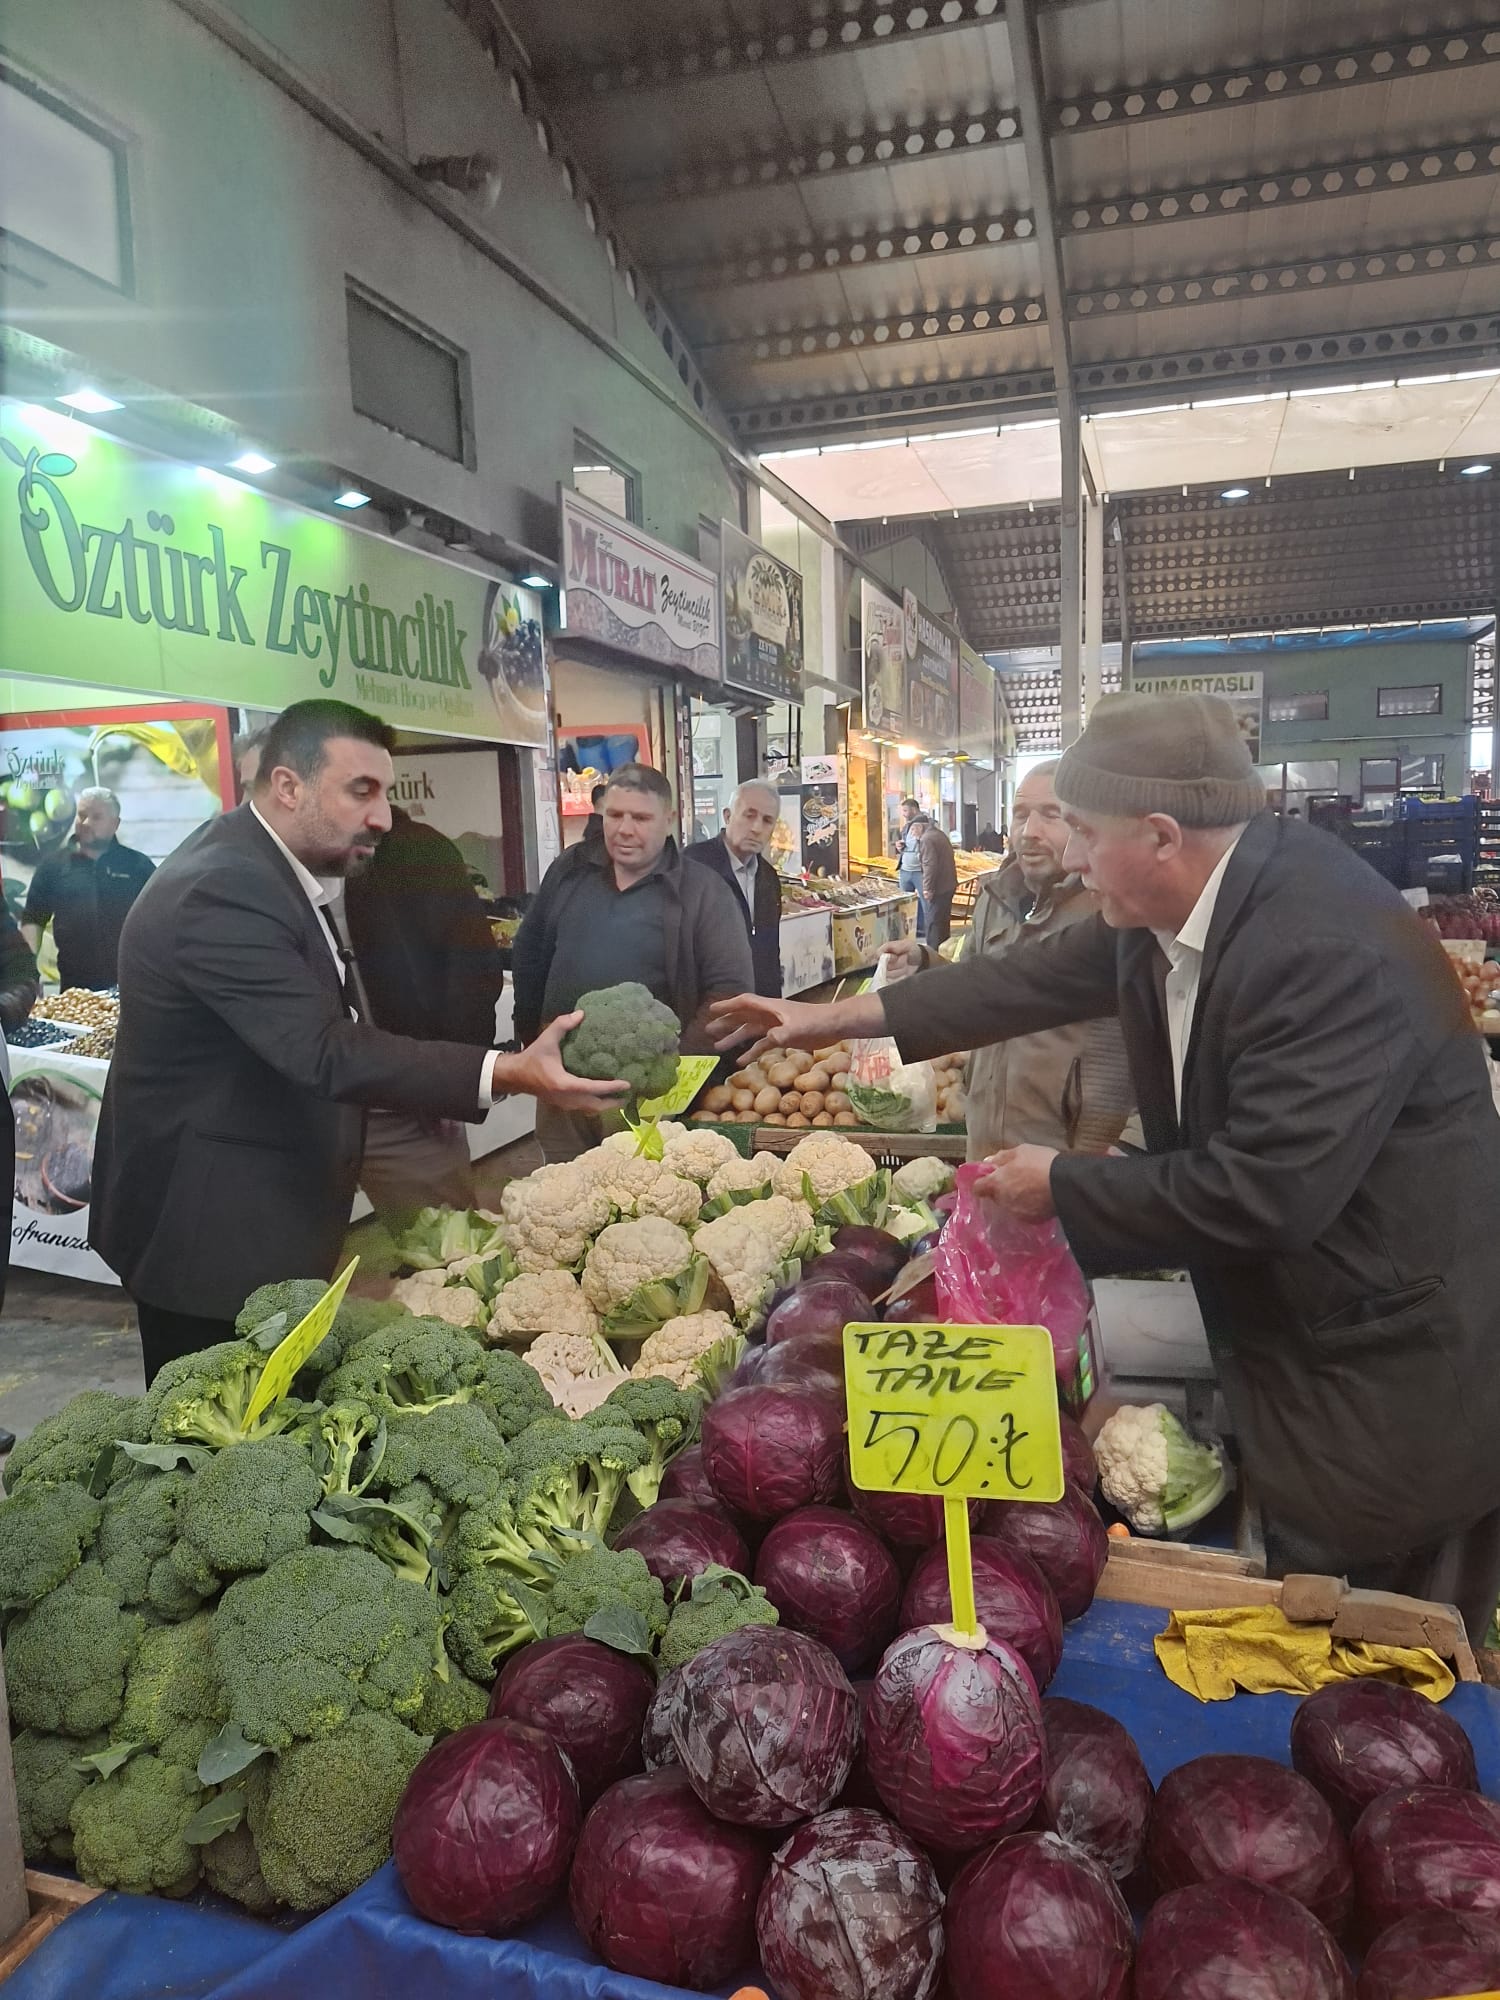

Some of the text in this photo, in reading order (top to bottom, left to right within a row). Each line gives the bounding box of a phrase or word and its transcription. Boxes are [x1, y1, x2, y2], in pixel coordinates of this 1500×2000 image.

[18, 447, 472, 688] Öztürk Zeytincilik
[567, 518, 710, 622] MURAT Zeytincilik
[11, 1216, 93, 1251] ofranıza
[854, 1329, 1004, 1360] TAZE
[866, 1363, 1025, 1397] TANE
